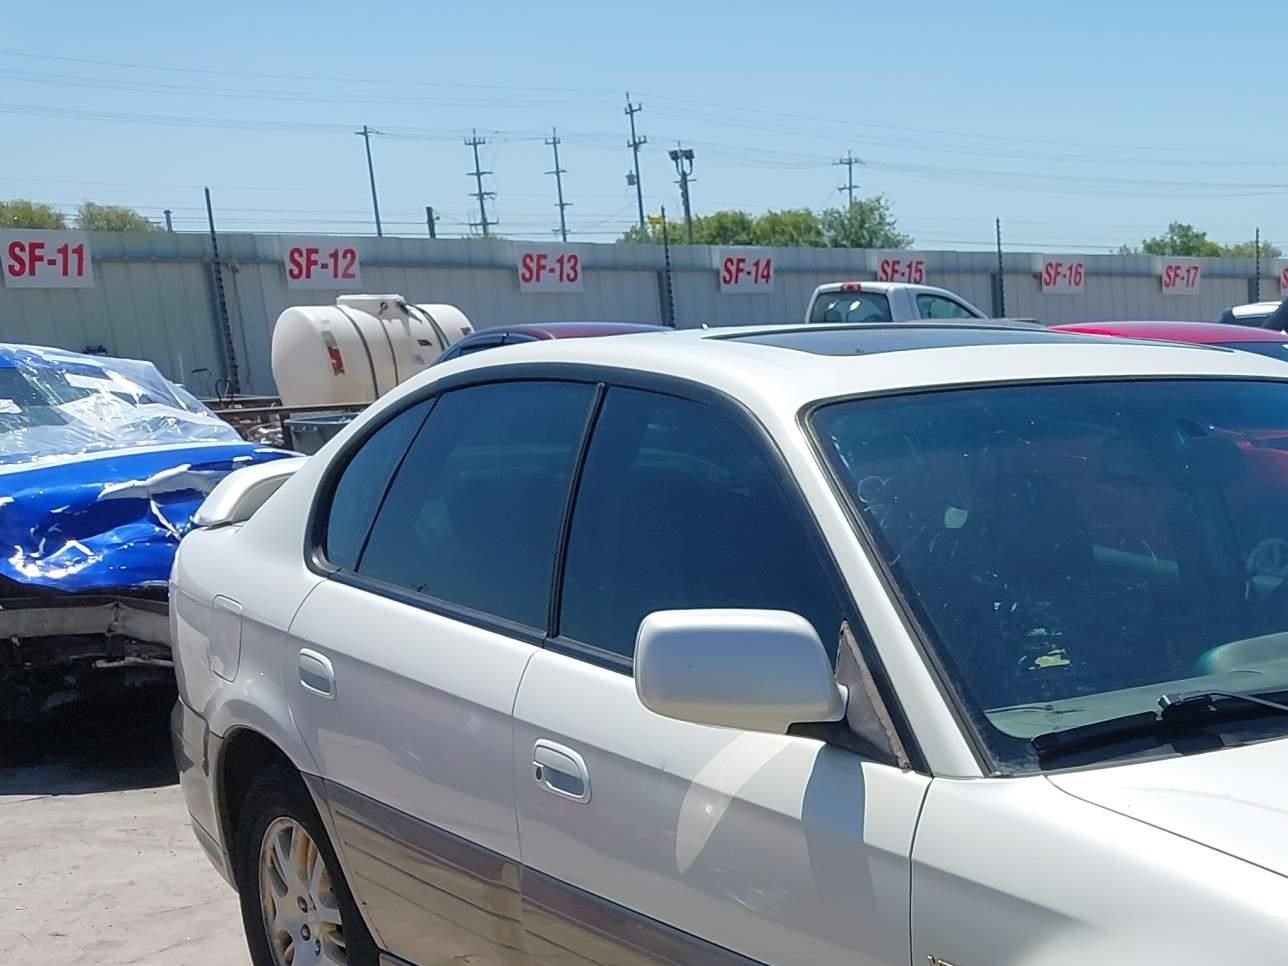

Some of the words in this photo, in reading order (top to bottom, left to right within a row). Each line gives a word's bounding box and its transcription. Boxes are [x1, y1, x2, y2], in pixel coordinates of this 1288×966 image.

[8, 241, 86, 277] SF-11
[288, 248, 356, 280] SF-12
[521, 253, 580, 284] SF-13
[722, 257, 772, 285] SF-14
[880, 260, 923, 282] SF-15
[1043, 262, 1083, 287] SF-16
[1164, 264, 1199, 288] SF-17
